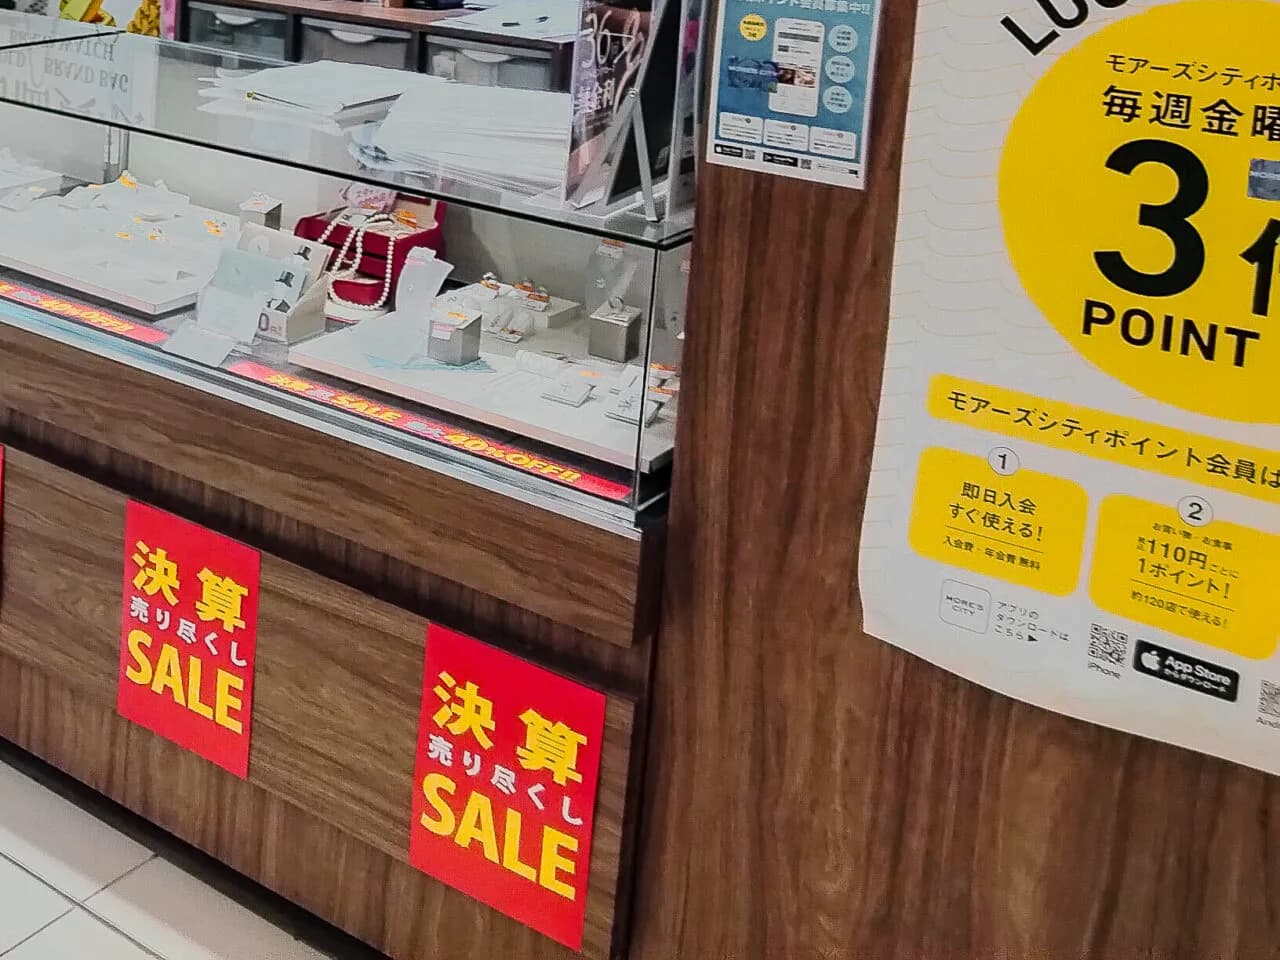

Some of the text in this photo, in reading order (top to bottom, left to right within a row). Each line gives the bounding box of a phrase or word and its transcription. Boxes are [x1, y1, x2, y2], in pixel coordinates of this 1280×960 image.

[1081, 299, 1260, 368] POINT
[329, 394, 402, 422] SALE
[961, 482, 1037, 515] 即日入会
[131, 540, 249, 633] 決算
[129, 595, 248, 667] 売り尽くし
[1164, 656, 1233, 686] App Store
[125, 629, 244, 735] SALE
[432, 670, 588, 786] 決算
[427, 733, 583, 826] 売り尽くし
[420, 772, 579, 901] SALE
